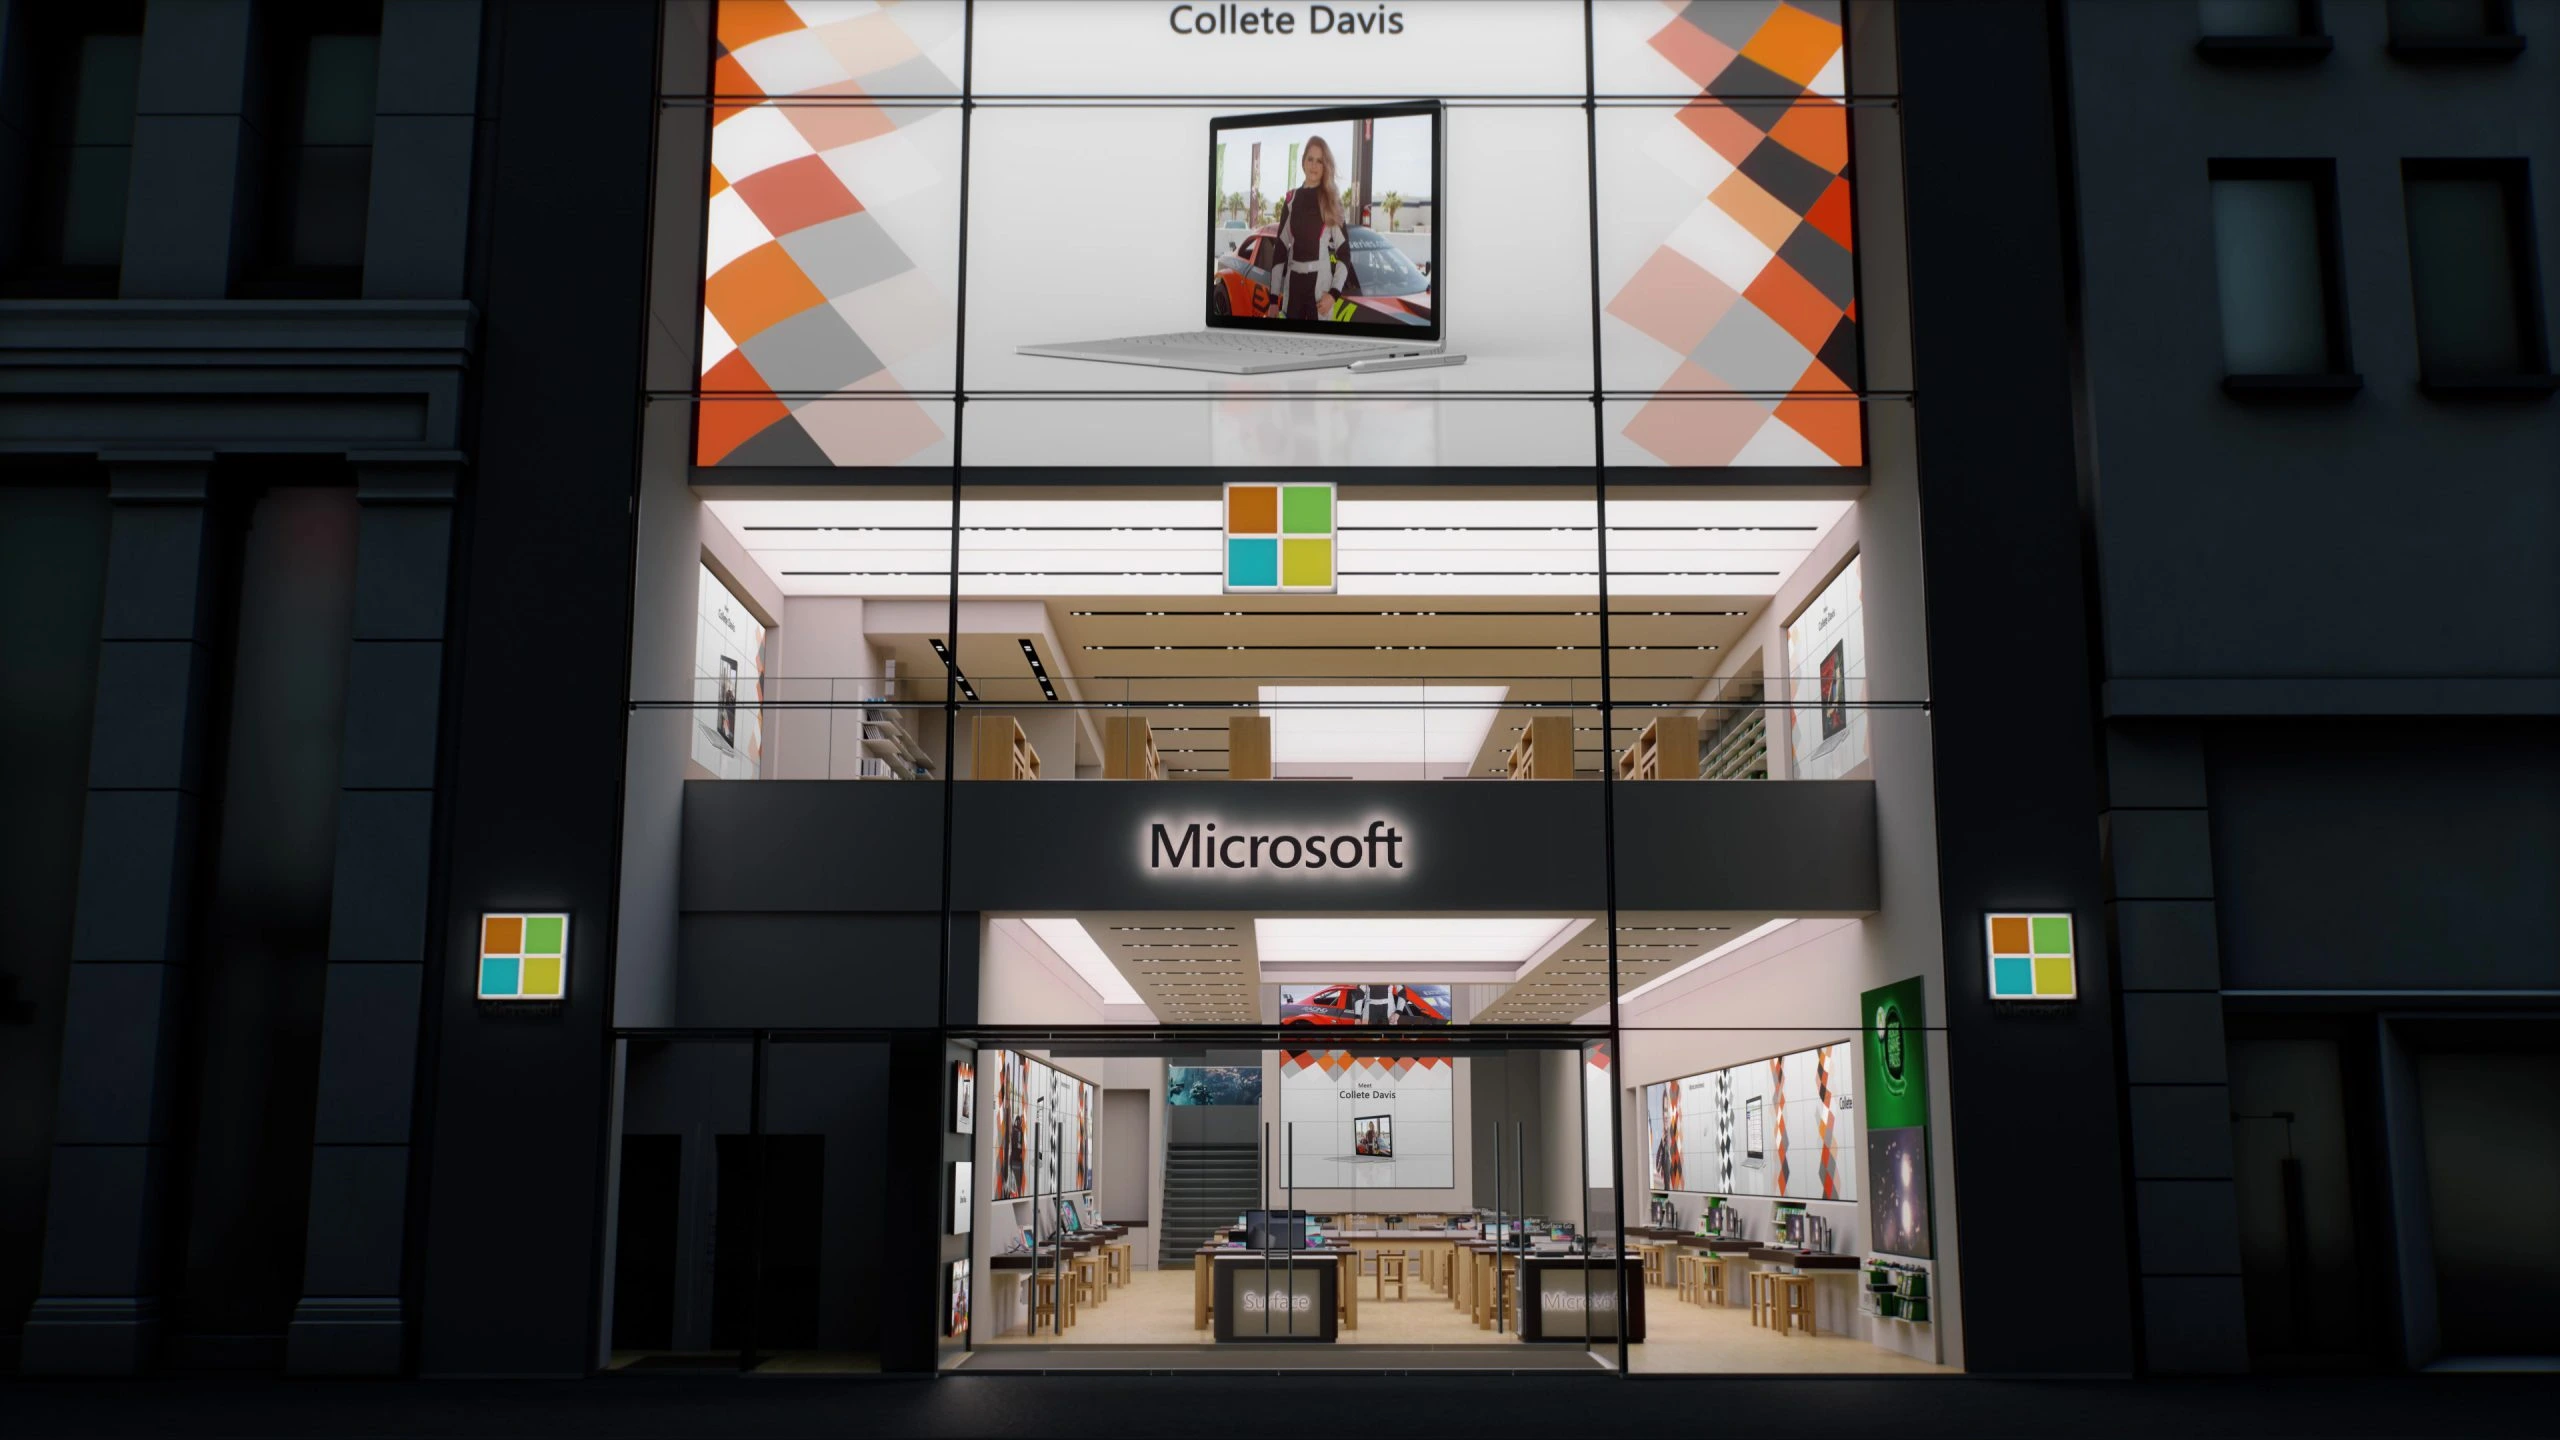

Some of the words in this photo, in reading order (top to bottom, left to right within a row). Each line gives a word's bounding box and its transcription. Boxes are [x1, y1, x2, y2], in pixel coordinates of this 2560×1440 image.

[1170, 4, 1295, 35] Collete
[1310, 4, 1404, 35] Davis
[1152, 821, 1403, 868] Microsoft
[1339, 1090, 1370, 1099] Collete
[1372, 1090, 1396, 1099] Davis
[1244, 1292, 1310, 1311] Surface
